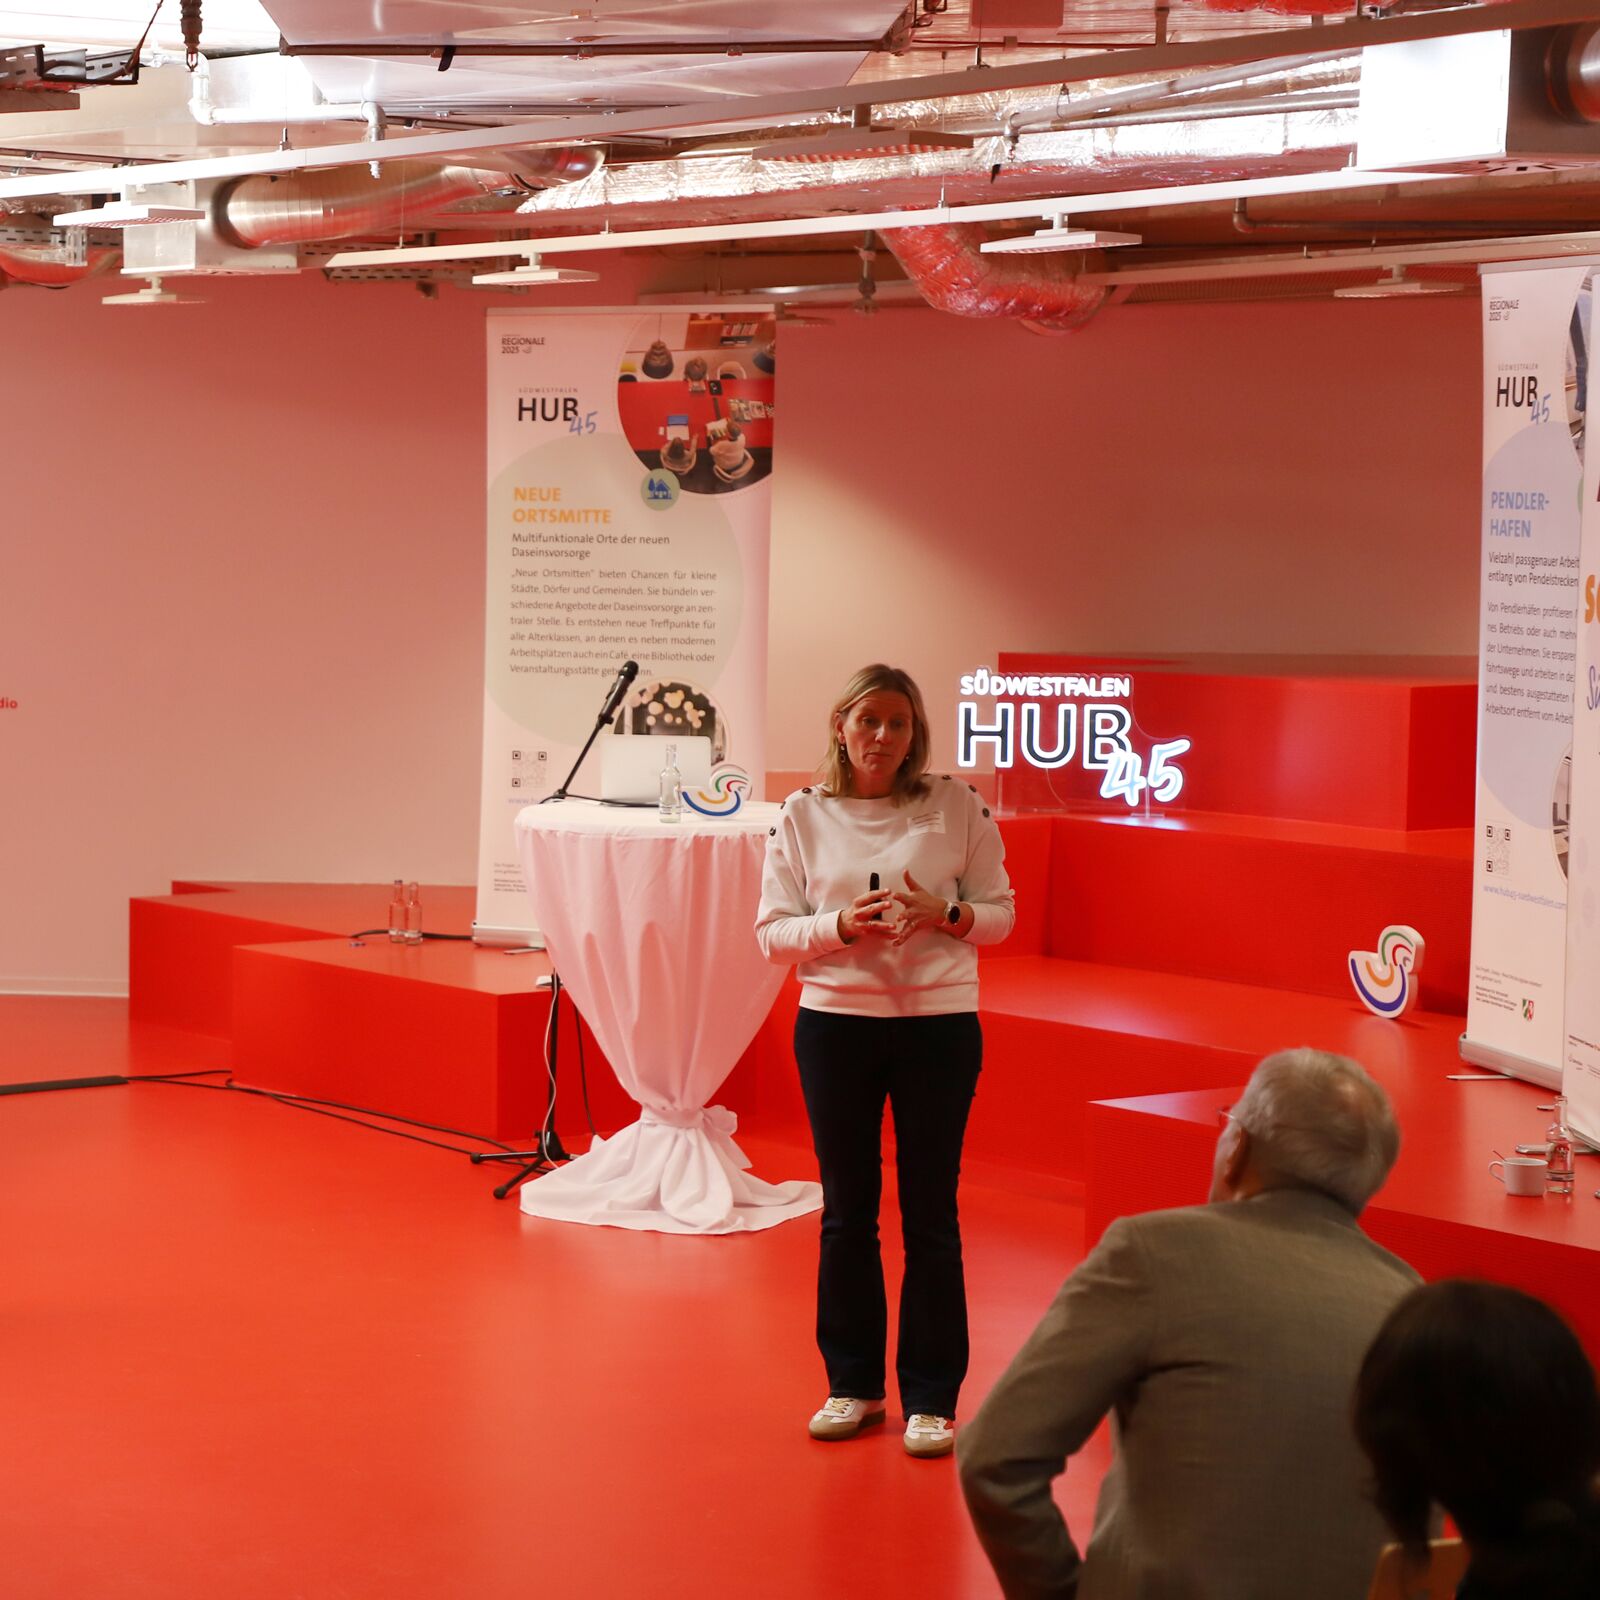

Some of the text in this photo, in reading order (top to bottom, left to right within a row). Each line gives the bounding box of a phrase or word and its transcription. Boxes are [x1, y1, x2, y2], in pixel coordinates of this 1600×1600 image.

[502, 337, 545, 346] REGIONALE
[1496, 376, 1538, 408] HUB
[518, 397, 579, 422] HUB
[1530, 393, 1551, 425] 45
[569, 411, 598, 436] 45
[513, 487, 561, 501] NEUE
[1491, 491, 1550, 511] PENDLER-
[512, 508, 611, 524] ORTSMITTE
[1489, 519, 1531, 538] HAFEN
[512, 533, 670, 545] Multifunktionale Orte der neuen
[512, 547, 591, 561] Daseinsvorsorge
[1488, 552, 1514, 564] Vielzahl
[1515, 555, 1558, 569] passgenauer
[599, 569, 627, 579] bieten
[631, 569, 669, 580] Chancen
[673, 570, 687, 580] für
[691, 570, 717, 580] kleine
[1488, 570, 1579, 587] entlang von Pendelstrecken
[543, 584, 570, 594] Dörfer
[573, 585, 590, 594] und
[647, 586, 660, 596] Sie
[662, 586, 699, 596] bündeln
[700, 588, 717, 597] ver-
[511, 600, 717, 615] schiedene Angebote der Daseinsvorsorge an zen-
[510, 616, 533, 625] traler
[566, 617, 575, 627] Es
[578, 618, 622, 628] entstehen
[625, 619, 647, 629] neue
[650, 619, 700, 630] Treffpunkte
[703, 619, 716, 630] für
[510, 632, 526, 641] alle
[585, 634, 596, 643] an
[598, 634, 626, 644] denen
[628, 636, 638, 644] es
[640, 636, 668, 646] neben
[671, 636, 716, 646] modernen
[573, 650, 594, 659] auch
[595, 650, 608, 660] ein
[631, 651, 650, 661] eine
[651, 651, 694, 662] Bibliothek
[696, 652, 715, 662] oder
[510, 664, 599, 677] Veranstaltungsstätte
[601, 667, 619, 678] geb
[960, 668, 1130, 698] SÜDWESTFALEN
[957, 702, 1132, 770] HUB
[1100, 739, 1191, 807] 45
